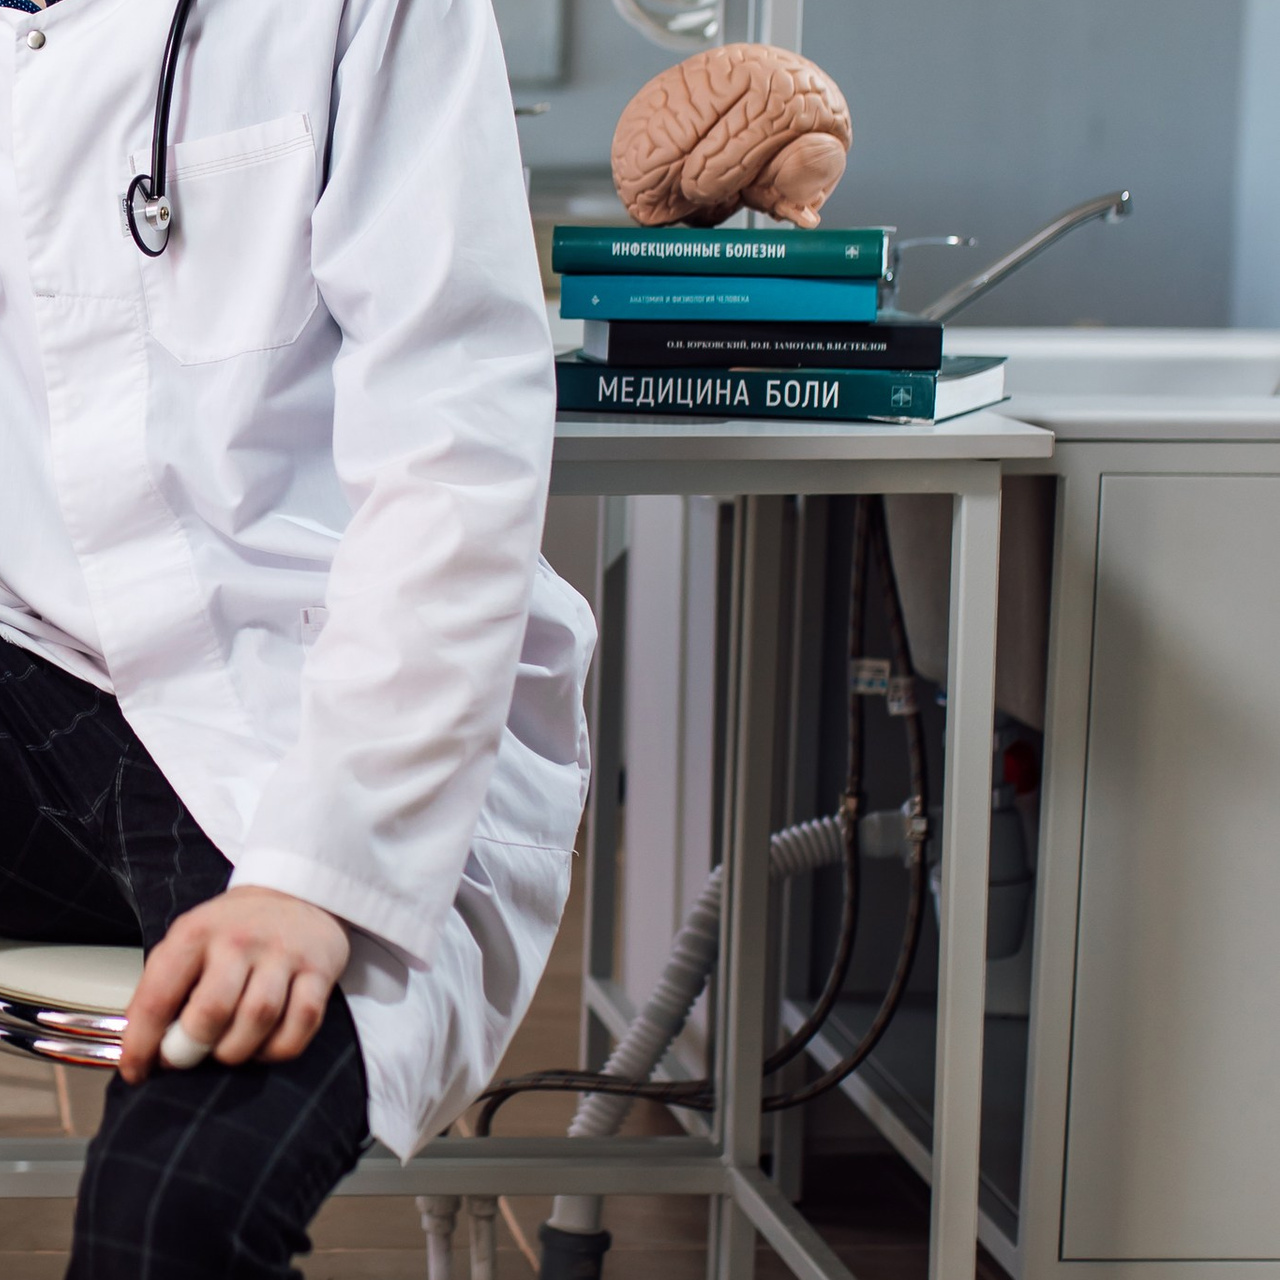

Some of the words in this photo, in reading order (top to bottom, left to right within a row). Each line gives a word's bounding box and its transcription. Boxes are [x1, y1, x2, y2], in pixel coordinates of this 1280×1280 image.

[611, 242, 721, 258] ИНФЕКЦИОННЫЕ
[725, 243, 786, 258] БОЛЕЗНИ
[629, 295, 664, 303] АНАТОМИЯ
[665, 295, 671, 303] И
[672, 295, 715, 303] ФИЗИОЛОГИЯ
[716, 295, 750, 303] ЧЕЛОВЕКА
[687, 339, 749, 350] ЮРКОВСКИЙ,
[598, 376, 750, 408] МЕДИЦИНА
[765, 379, 840, 409] БОЛИ
